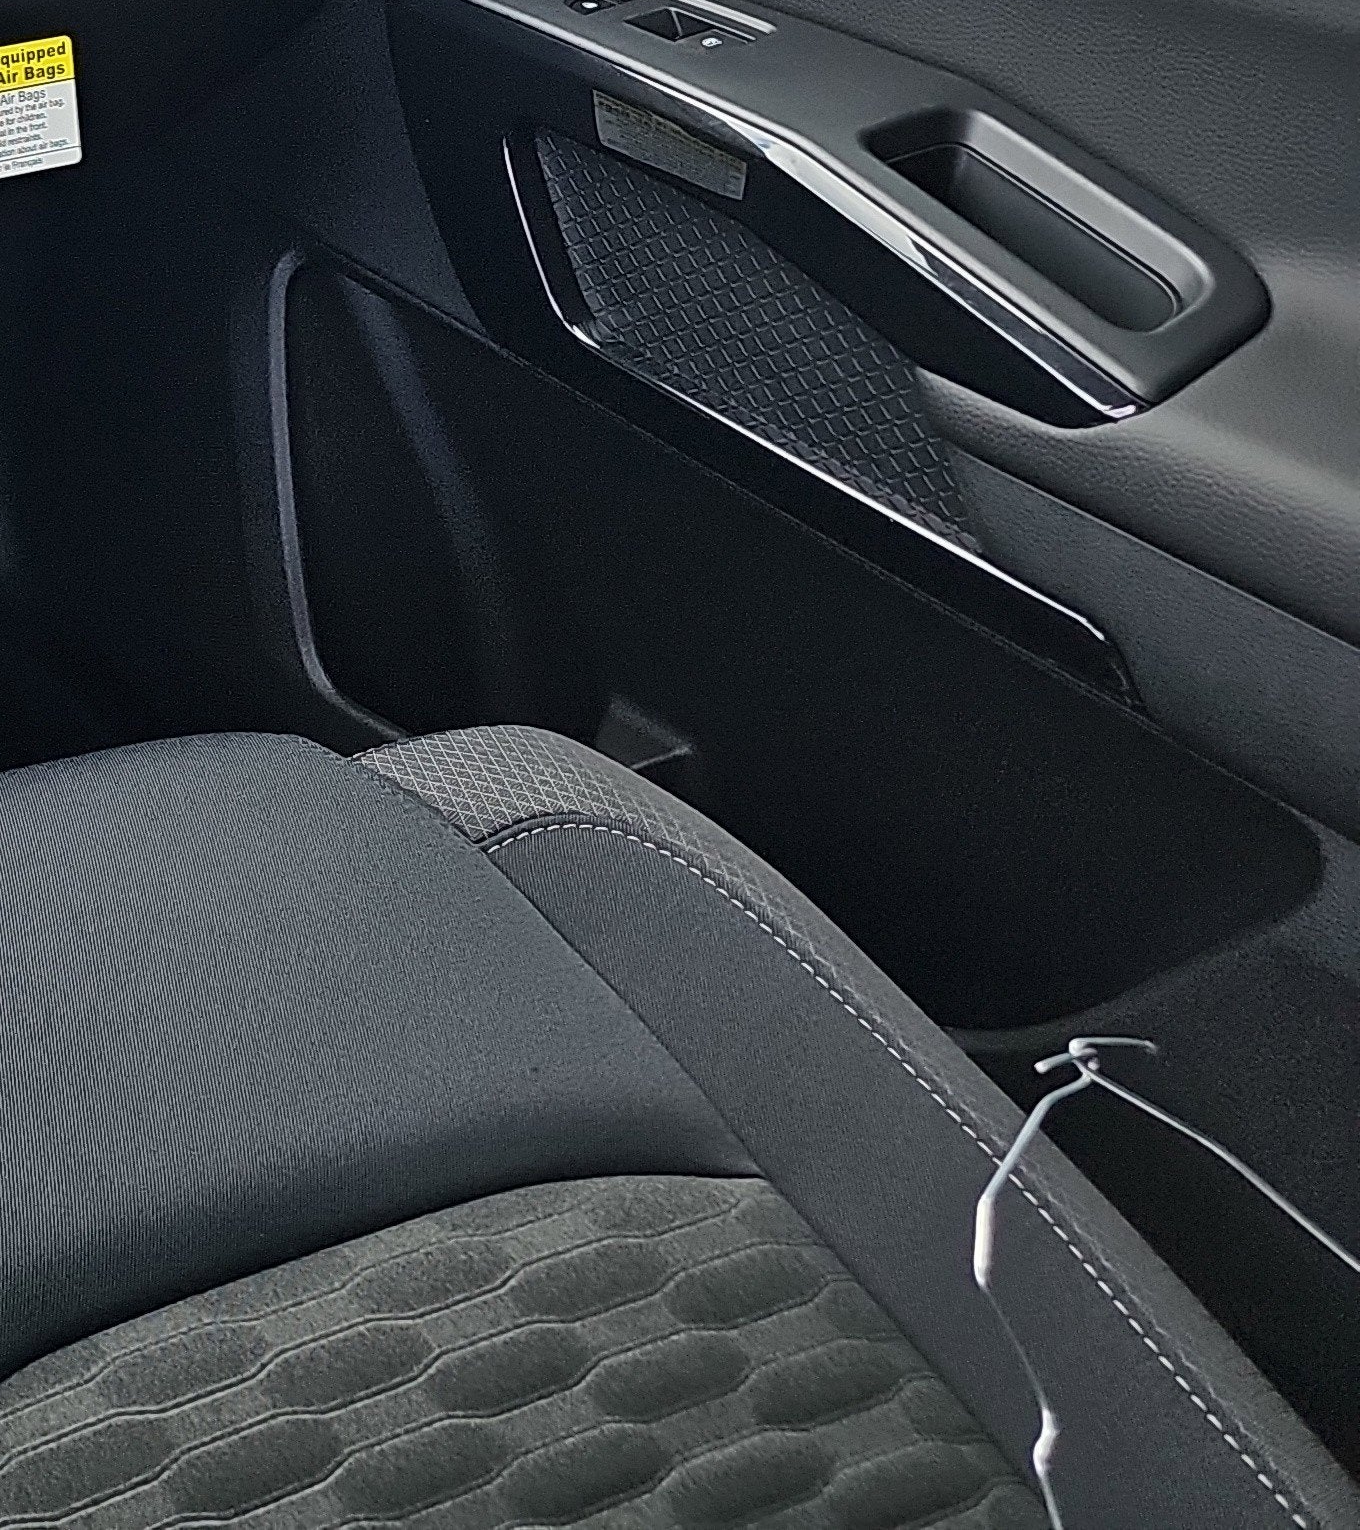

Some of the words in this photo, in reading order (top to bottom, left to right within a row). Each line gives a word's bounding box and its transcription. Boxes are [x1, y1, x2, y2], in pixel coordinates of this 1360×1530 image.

[24, 64, 66, 80] Bags
[0, 92, 16, 106] Air
[18, 90, 46, 106] Bags
